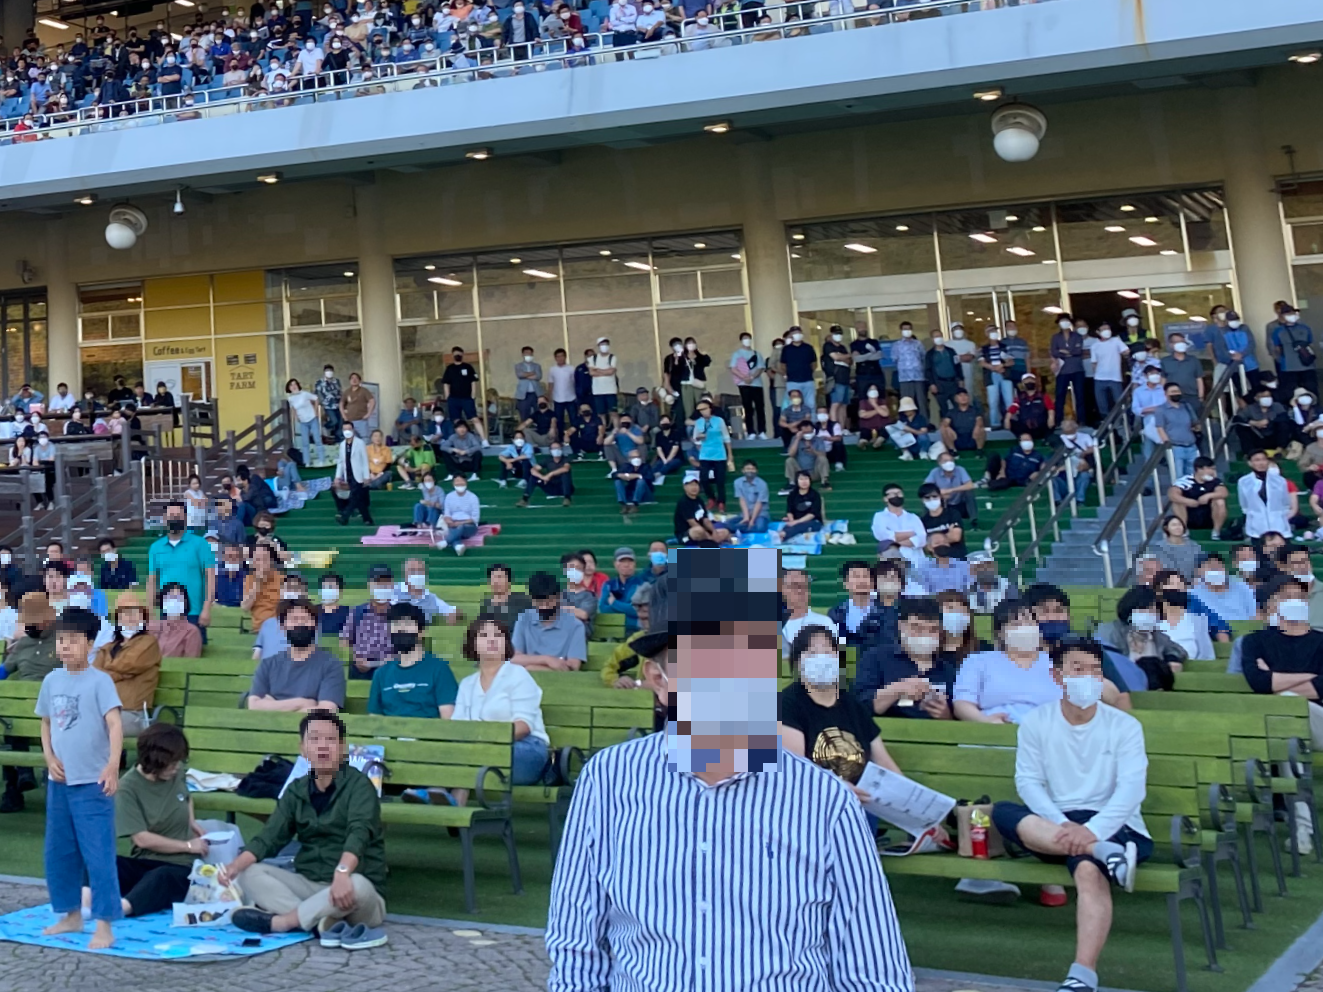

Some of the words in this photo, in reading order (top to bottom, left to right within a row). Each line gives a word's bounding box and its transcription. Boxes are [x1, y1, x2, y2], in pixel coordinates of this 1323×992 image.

[153, 345, 179, 356] Coffee
[229, 371, 255, 380] TART
[229, 381, 257, 390] FARM
